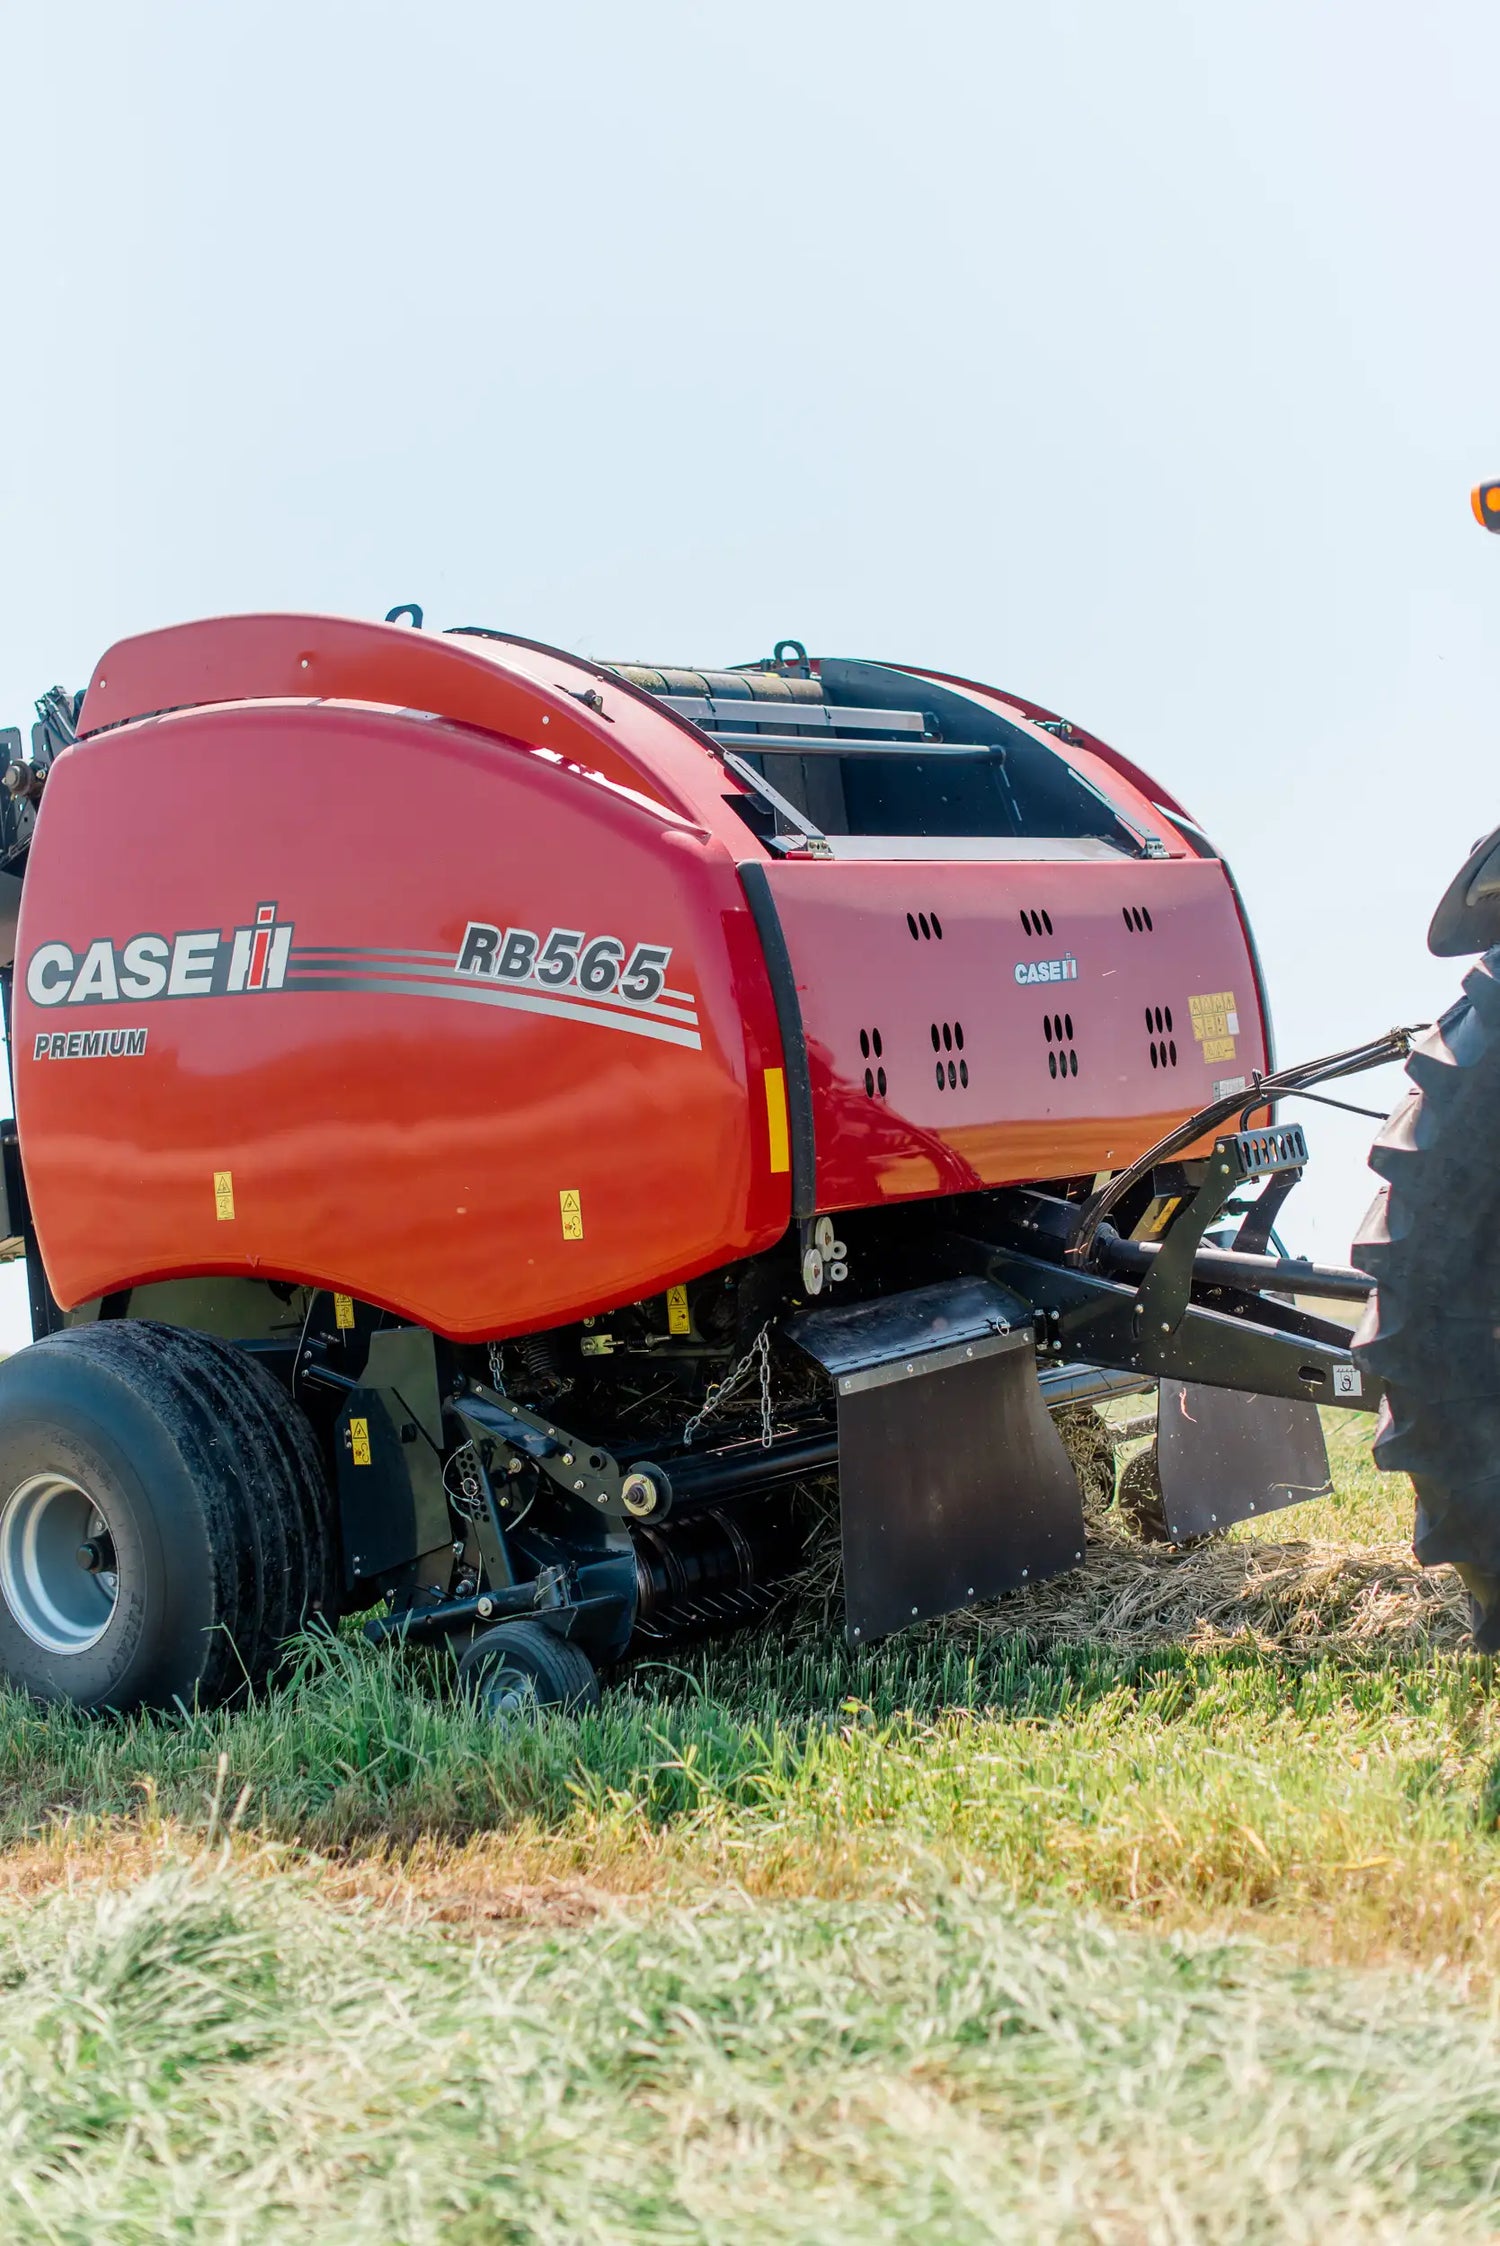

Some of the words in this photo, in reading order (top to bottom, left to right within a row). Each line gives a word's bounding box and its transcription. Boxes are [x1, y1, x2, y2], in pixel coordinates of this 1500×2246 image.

[27, 932, 220, 1004] CASE
[455, 921, 673, 1004] RB565
[1014, 960, 1061, 984] CASE
[33, 1028, 148, 1060] PREMIUM
